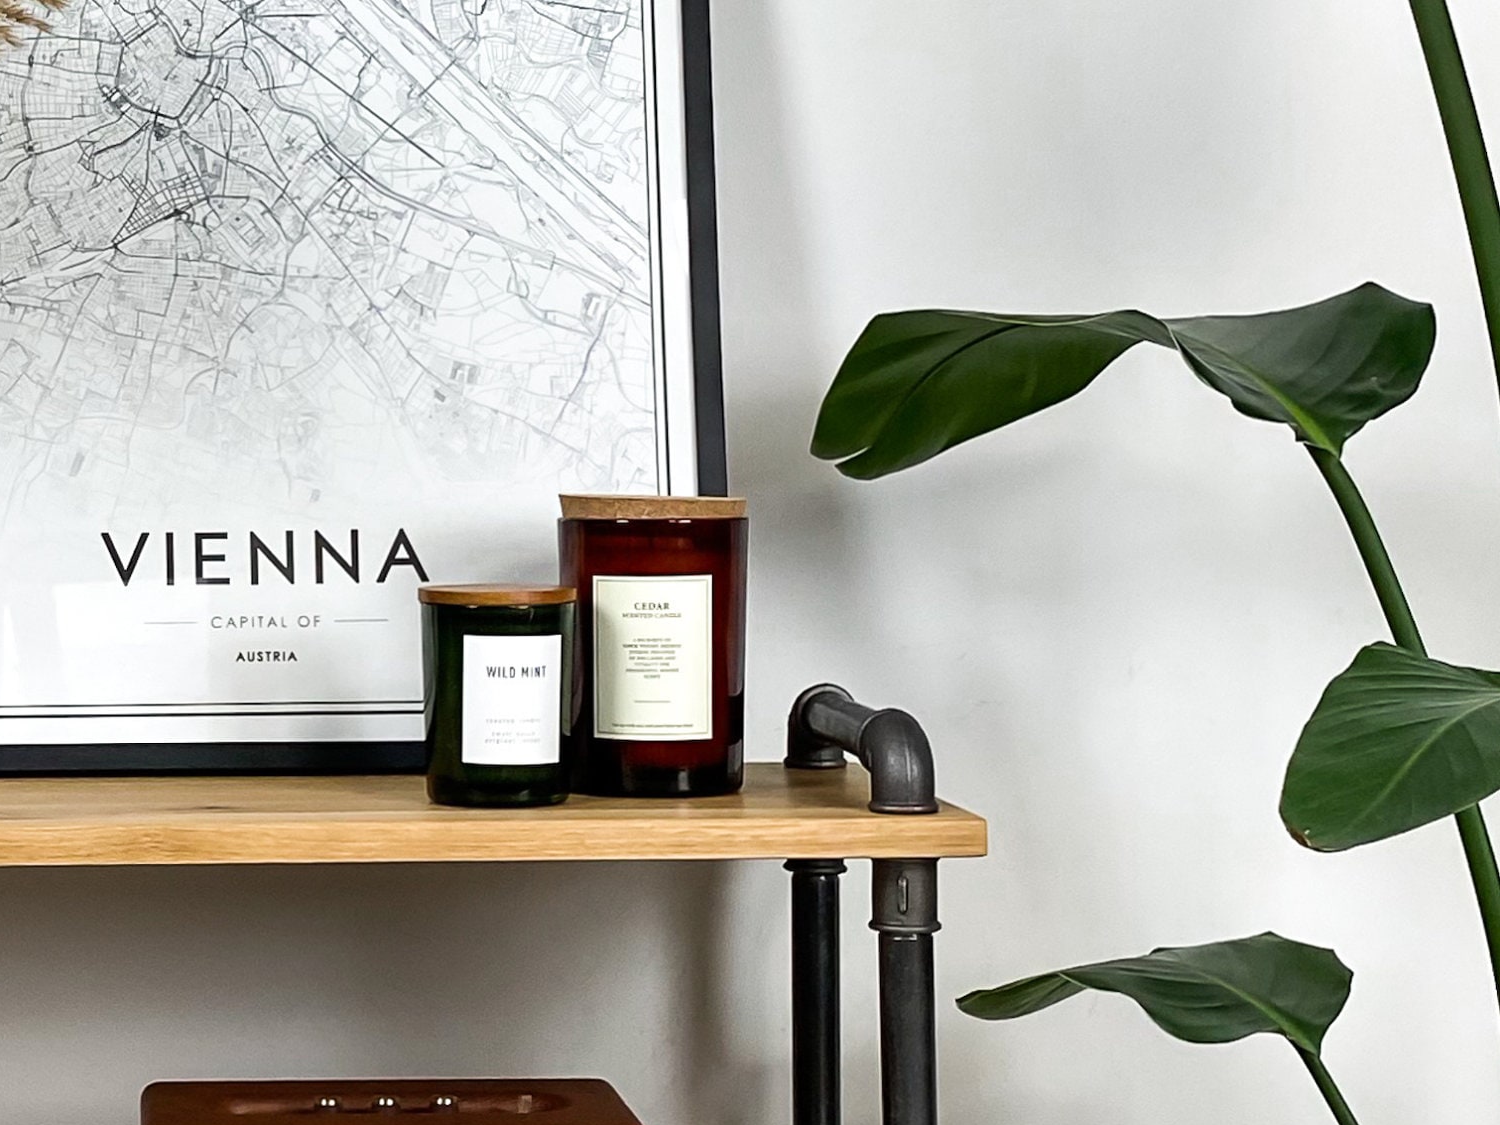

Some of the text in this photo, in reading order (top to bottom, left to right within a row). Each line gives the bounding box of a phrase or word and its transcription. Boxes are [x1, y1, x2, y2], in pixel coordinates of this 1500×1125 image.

[100, 528, 430, 587] VIENNA
[634, 602, 670, 611] CEDAR
[210, 615, 321, 629] CAPITAL OF
[235, 651, 298, 663] AUSTRIA
[486, 665, 547, 678] WILD MINT
